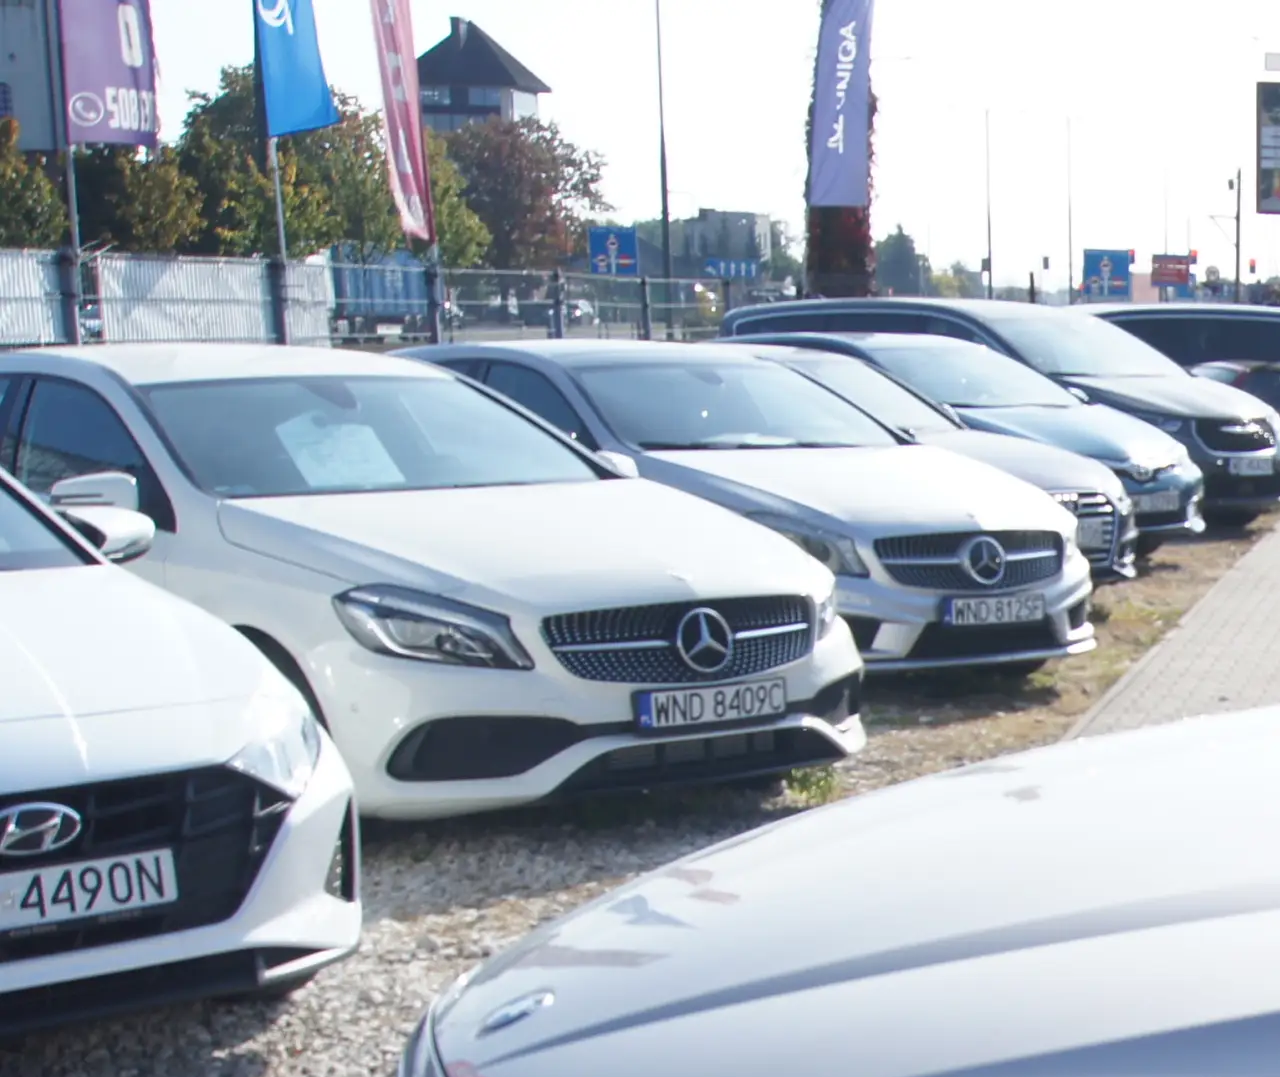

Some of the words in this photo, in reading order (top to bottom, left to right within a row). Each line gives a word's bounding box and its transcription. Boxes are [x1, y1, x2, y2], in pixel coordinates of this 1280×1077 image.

[954, 600, 990, 622] WND
[654, 692, 705, 725] WND
[713, 683, 783, 719] 8409C
[20, 854, 166, 919] 4490N
